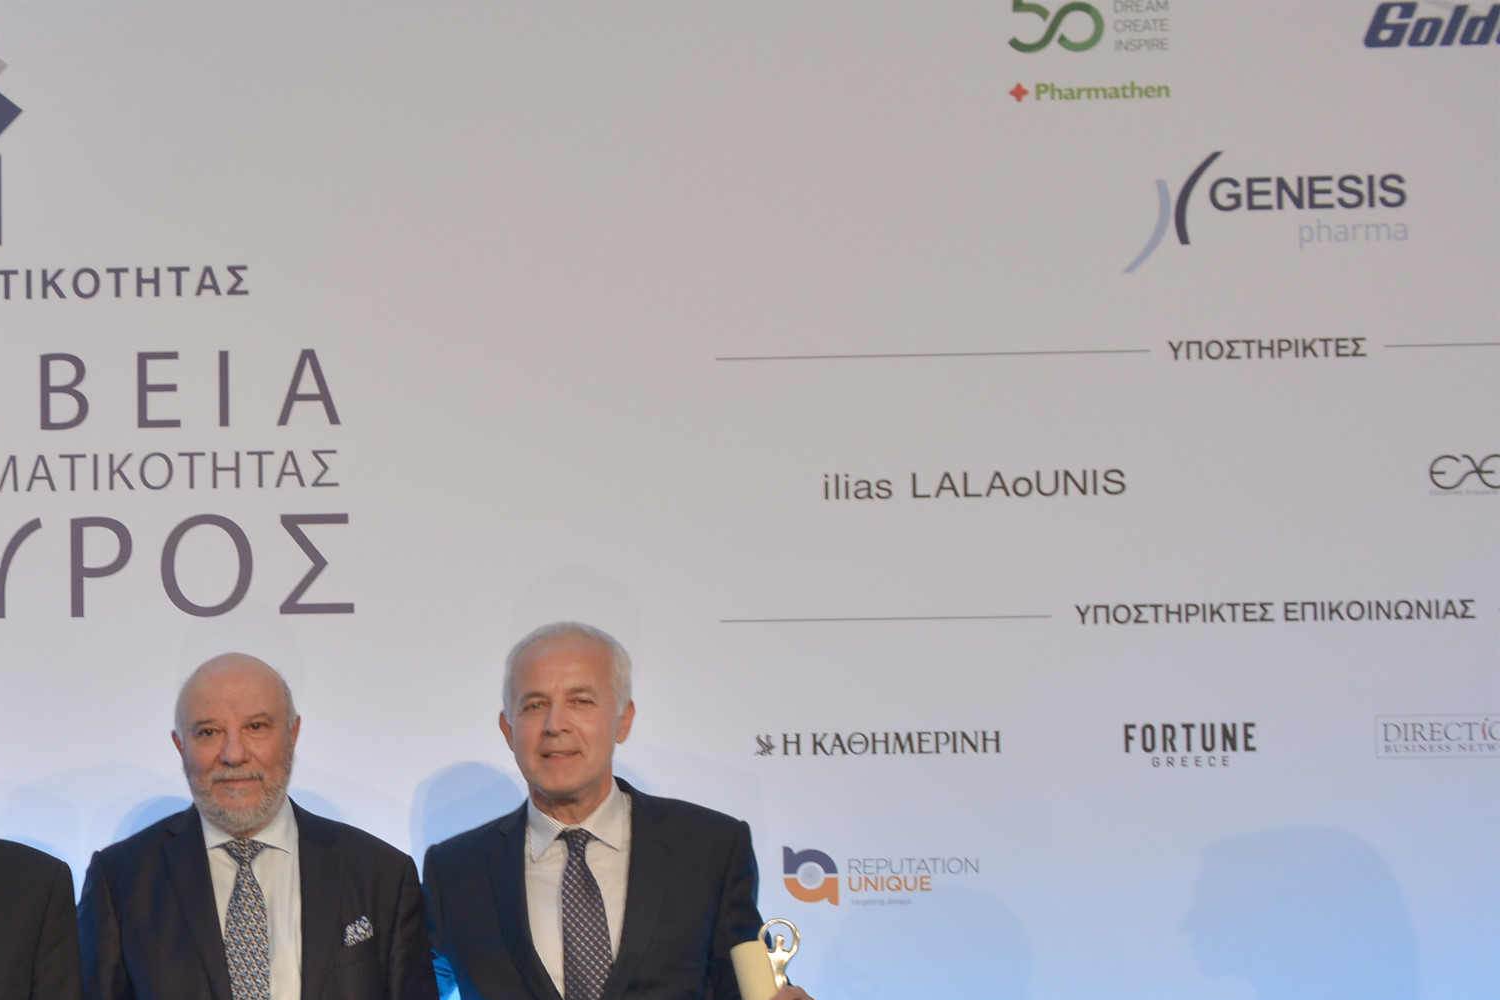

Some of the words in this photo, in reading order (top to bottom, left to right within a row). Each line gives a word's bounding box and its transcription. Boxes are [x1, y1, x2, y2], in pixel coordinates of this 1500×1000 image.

[1113, 0, 1169, 13] DREAM
[1113, 18, 1169, 33] CREATE
[1363, 2, 1500, 48] Gold
[1114, 37, 1170, 52] INSPIRE
[1035, 81, 1171, 101] Pharmathen
[1209, 174, 1407, 212] GENESIS
[1298, 218, 1409, 250] pharma
[1167, 337, 1368, 361] ΥΠΟΣΤΗΡΙΚΤΕΣ
[823, 472, 894, 501] ilias
[911, 468, 1127, 499] LALAoUNIS
[1075, 602, 1275, 625] ΥΠΟΣΤΗΡΙΚΤΕΣ
[1283, 599, 1476, 623] ΕΠΙΚΟΙΝΩΝΙΑΣ
[781, 732, 802, 756] Η
[811, 730, 1002, 756] ΚΑΘΗΜΕΡΙΝΗ
[1123, 722, 1257, 754] FORTUNE
[1384, 743, 1453, 753] BUSINESS
[1457, 743, 1500, 753] NETW
[1151, 755, 1231, 768] GREECE
[848, 857, 981, 875] REPUTATION
[848, 875, 932, 892] UNIQUE
